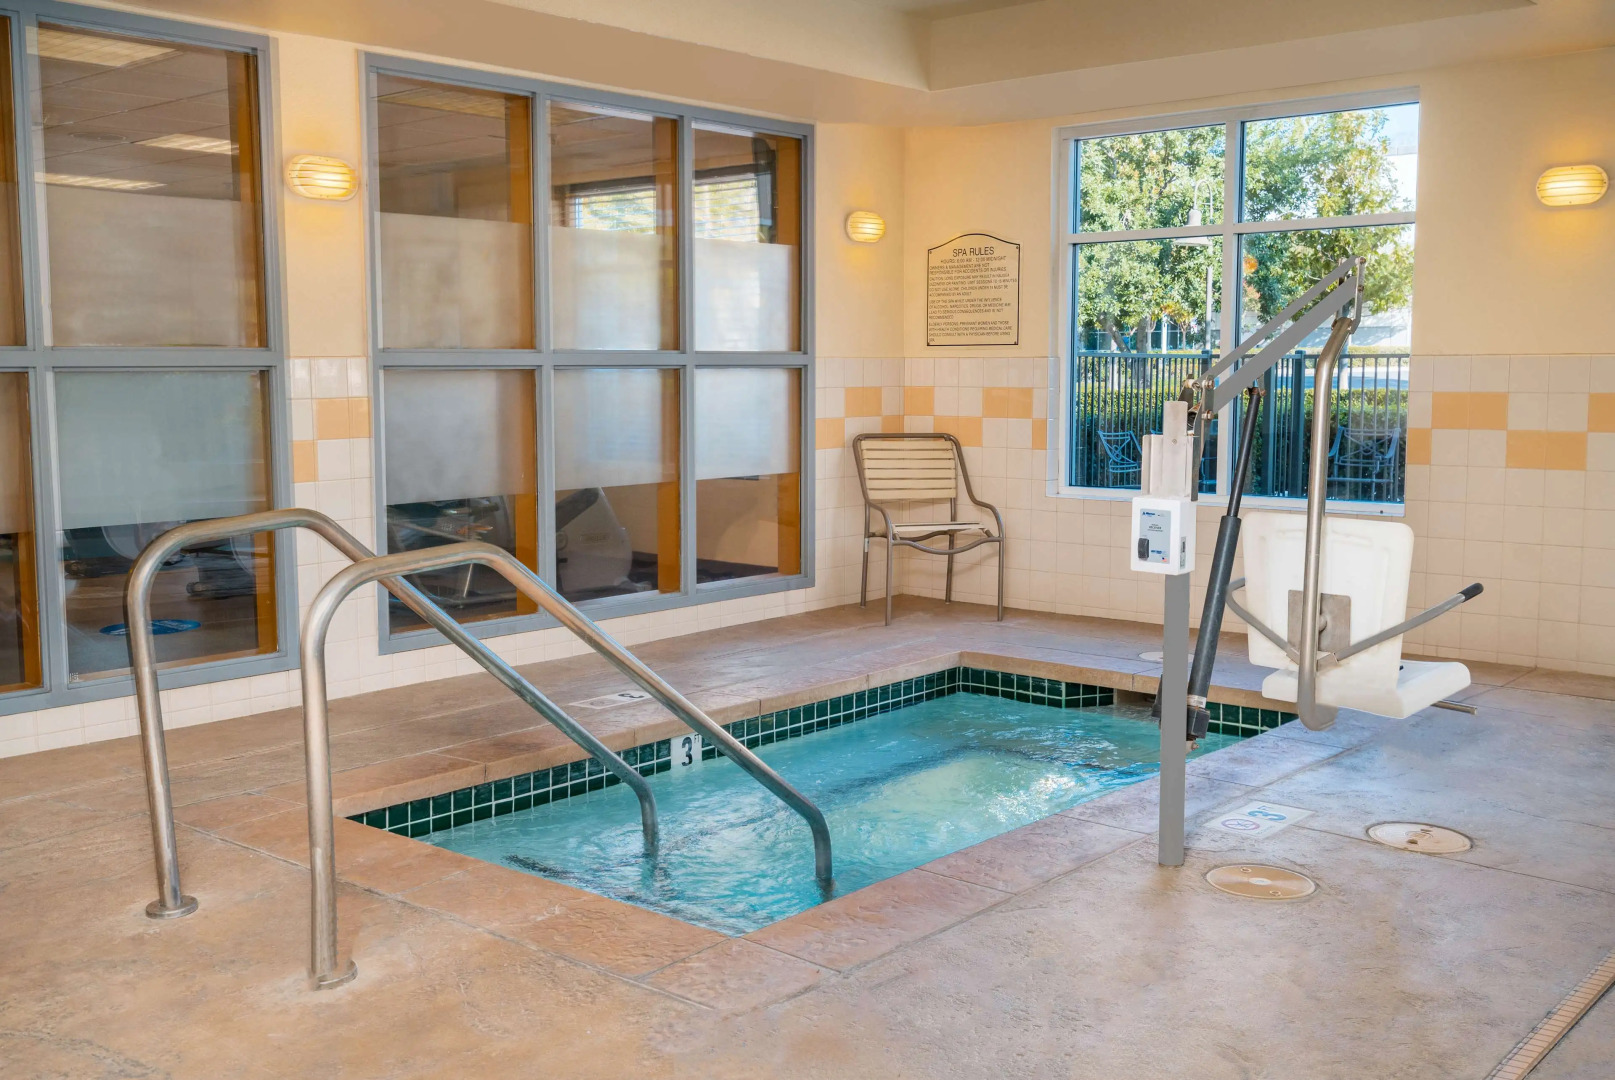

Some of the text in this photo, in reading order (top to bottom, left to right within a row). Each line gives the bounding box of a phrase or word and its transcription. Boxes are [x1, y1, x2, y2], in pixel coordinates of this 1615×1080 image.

[952, 246, 995, 258] SPA RULES
[681, 736, 693, 766] 3
[1247, 810, 1287, 821] 3
